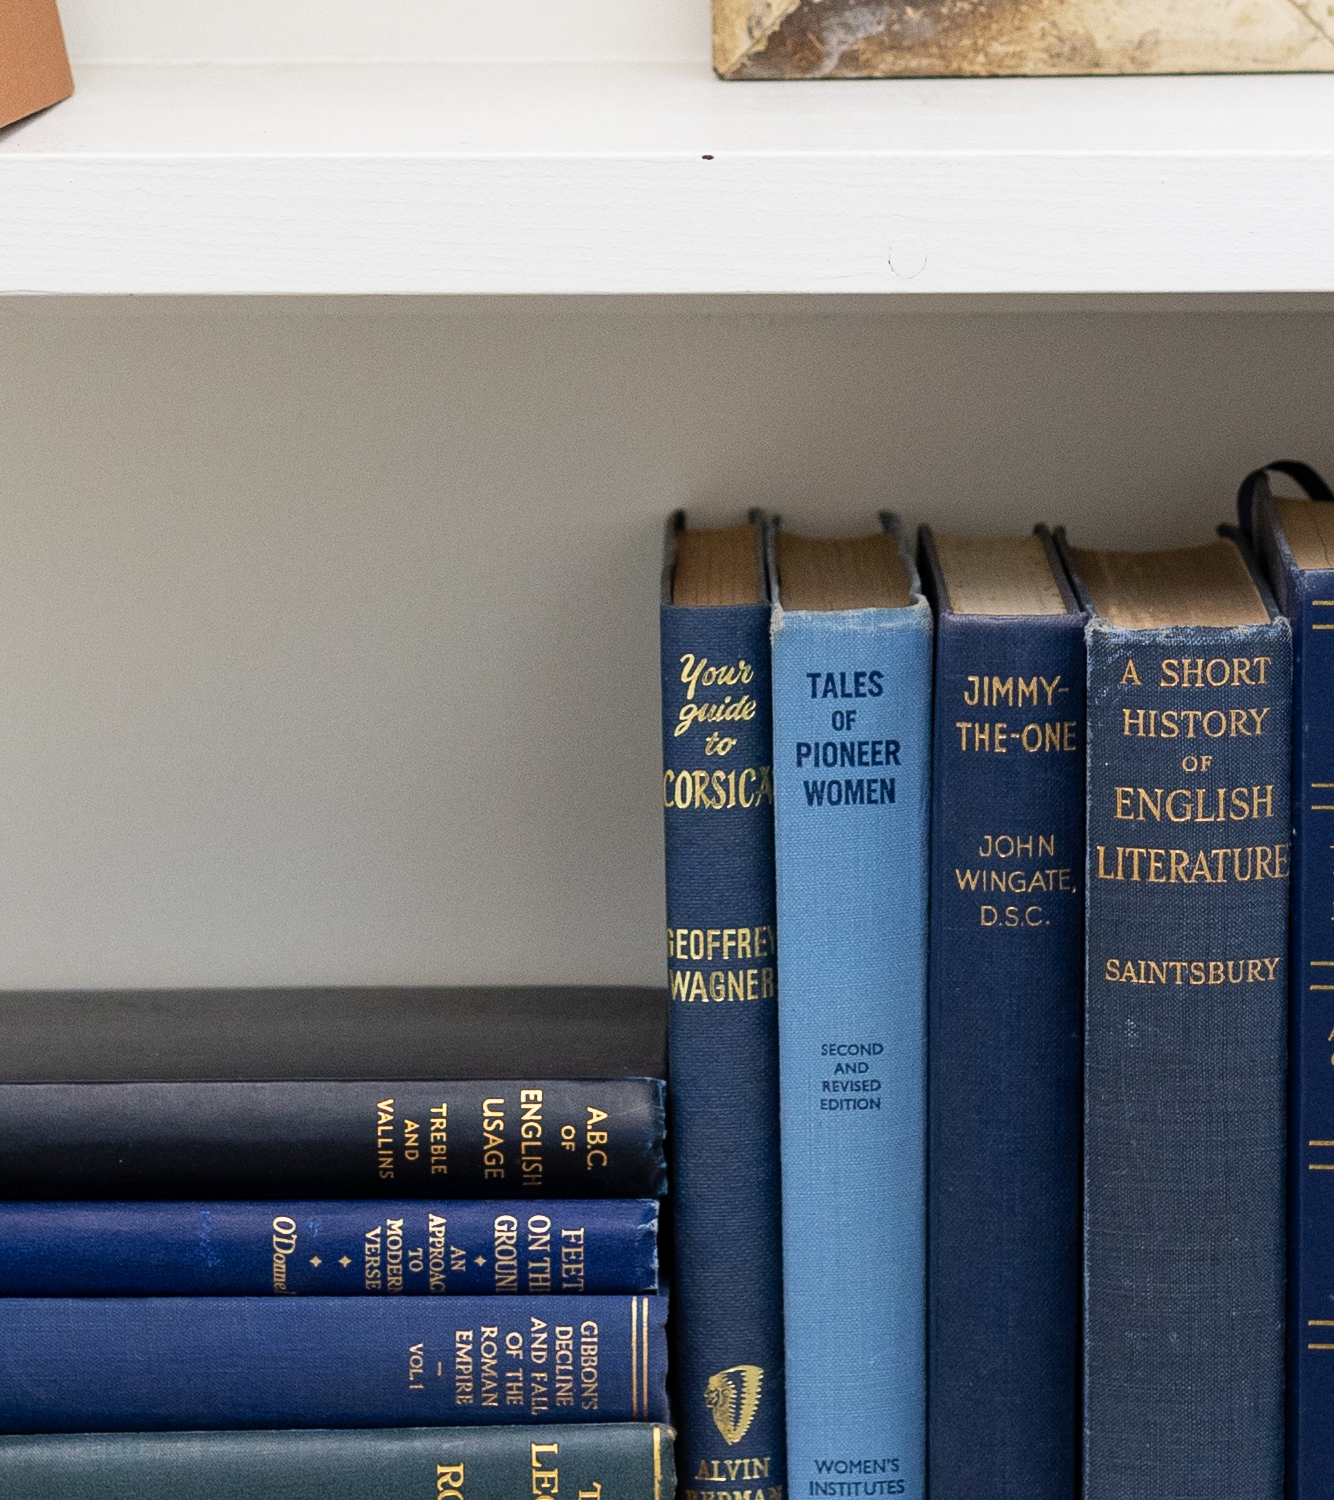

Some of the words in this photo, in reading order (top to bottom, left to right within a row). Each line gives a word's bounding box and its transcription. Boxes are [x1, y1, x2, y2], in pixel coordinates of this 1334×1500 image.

[680, 653, 754, 700] Your
[806, 670, 884, 698] TALES
[1120, 659, 1142, 687] A
[1160, 656, 1272, 688] SHORT
[674, 696, 757, 738] guide
[1122, 707, 1271, 738] HISTORY
[795, 740, 901, 767] PIONEER
[803, 778, 897, 807] WOMEN
[1114, 785, 1274, 822] ENGLISH
[978, 834, 1056, 858] JOHN
[1096, 844, 1290, 884] LITERATURE
[1104, 956, 1281, 985] SAINTSBURY
[821, 1043, 884, 1057] SECOND
[822, 1080, 882, 1093] REVISED
[808, 1477, 905, 1498] INSTITUTES
